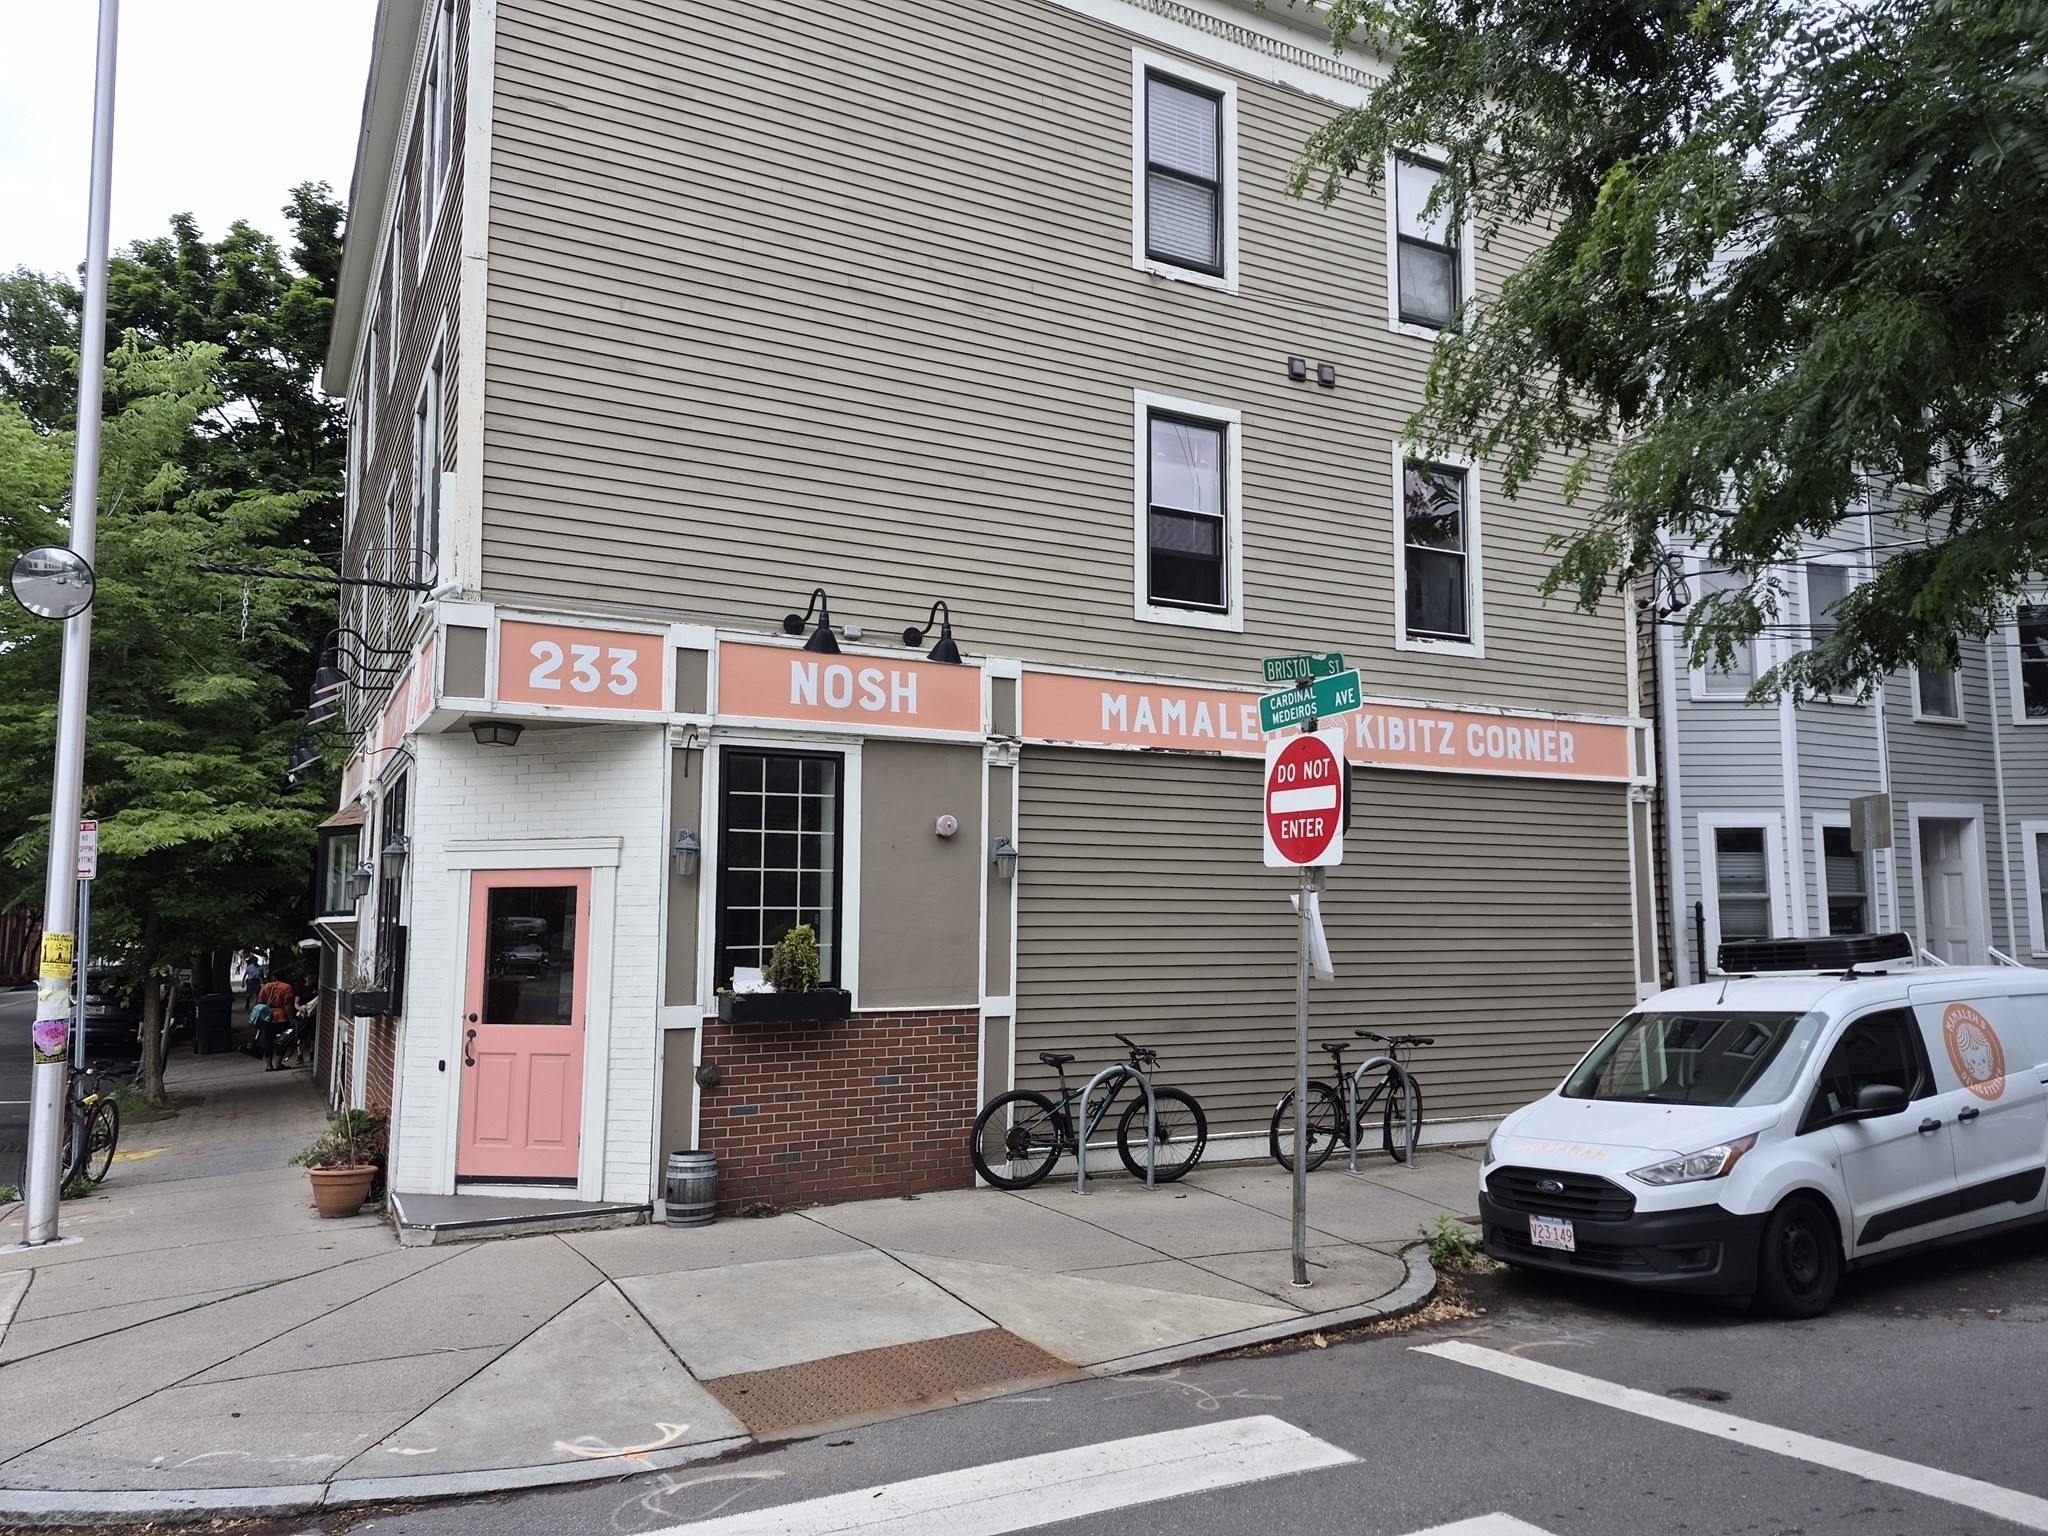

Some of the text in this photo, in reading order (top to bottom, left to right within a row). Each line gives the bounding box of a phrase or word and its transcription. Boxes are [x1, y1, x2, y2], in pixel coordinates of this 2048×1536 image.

[529, 640, 638, 696] 233
[1267, 658, 1341, 680] BRISTOL ST
[789, 660, 918, 715] NOSH
[1270, 687, 1317, 710] CARDINAL
[1335, 688, 1356, 708] AVE
[1272, 702, 1318, 725] MEDEIROS
[1355, 713, 1455, 755] KIBITZ
[1466, 723, 1575, 764] CORNER
[1277, 758, 1331, 784] DO NOT
[81, 834, 88, 842] NO
[1281, 817, 1324, 839] ENTER
